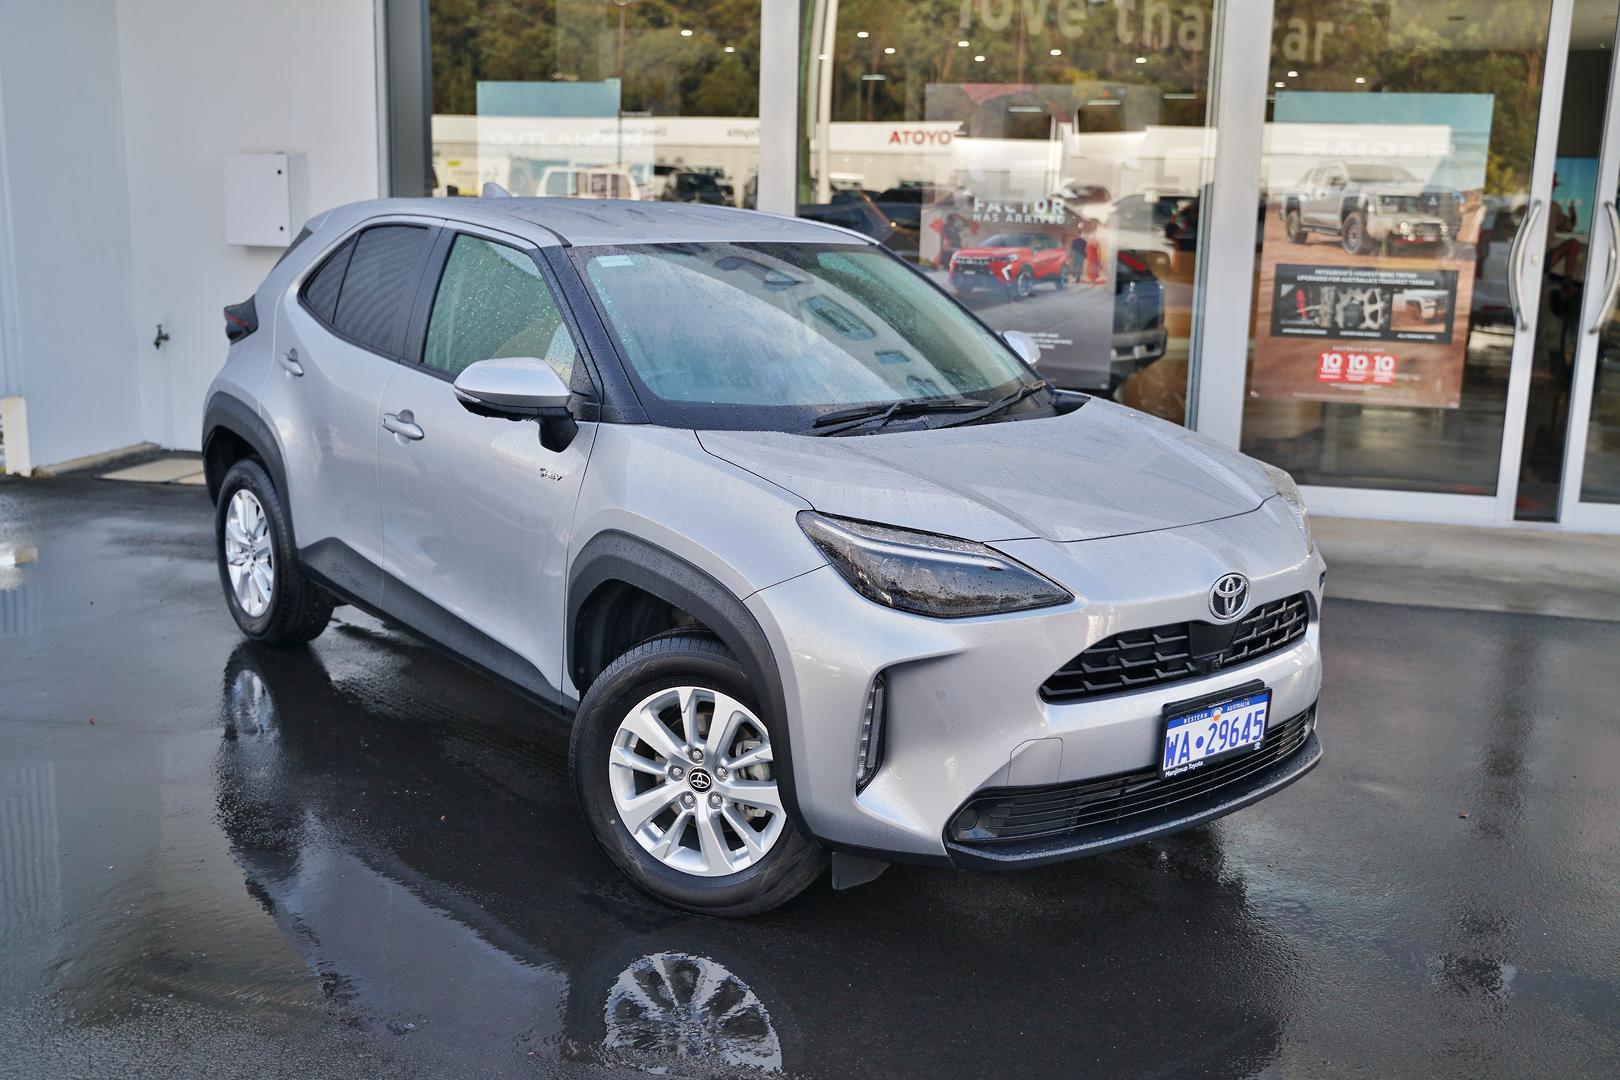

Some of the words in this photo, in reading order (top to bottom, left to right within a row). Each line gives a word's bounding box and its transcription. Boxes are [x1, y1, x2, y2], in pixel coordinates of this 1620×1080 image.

[1114, 0, 1205, 51] tha
[1321, 353, 1342, 369] 10
[1347, 354, 1368, 370] 10
[1374, 356, 1394, 371] 10
[1183, 712, 1208, 724] WESTERN
[1226, 700, 1250, 712] AUSTRALIA
[1165, 764, 1188, 778] Manjimup
[1188, 761, 1204, 771] Toyota
